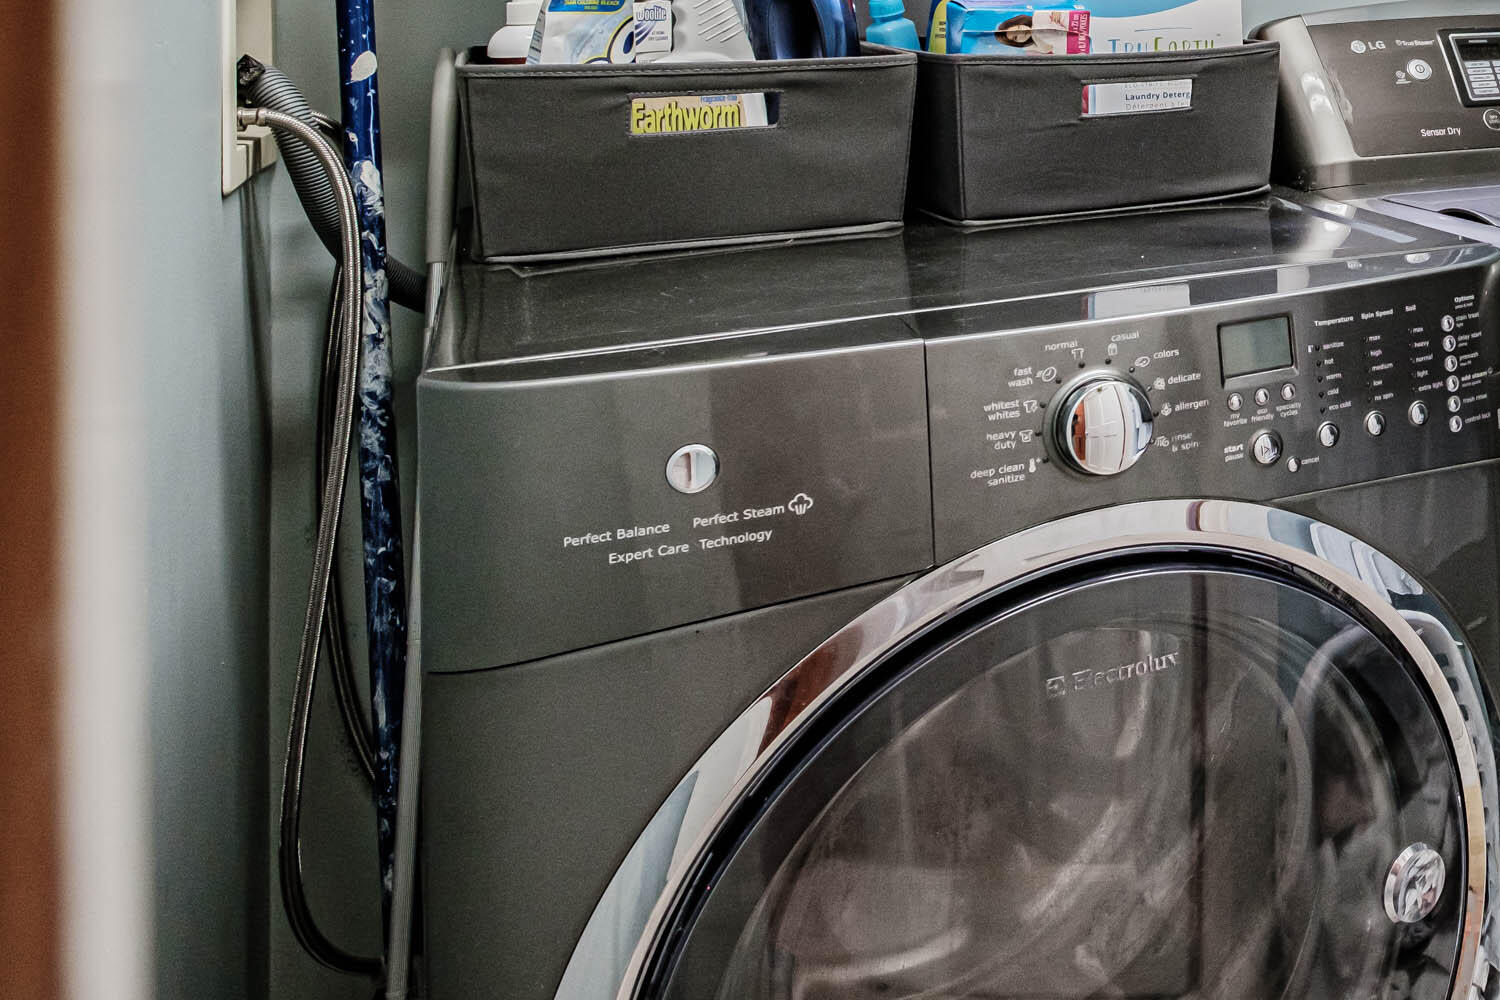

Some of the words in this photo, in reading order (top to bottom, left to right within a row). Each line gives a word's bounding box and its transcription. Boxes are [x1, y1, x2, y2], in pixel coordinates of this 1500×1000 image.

[636, 5, 667, 22] Woolite
[1368, 40, 1386, 50] LG
[1125, 92, 1160, 101] Laundry
[632, 101, 741, 134] Earthworm
[1420, 128, 1446, 137] Sensor
[1447, 126, 1460, 136] Dry
[1361, 312, 1374, 320] Spin
[1375, 308, 1394, 318] Speed
[1314, 316, 1354, 326] Temperature
[1111, 331, 1139, 342] casual
[1044, 340, 1078, 351] normal
[1153, 349, 1180, 359] colors
[1014, 366, 1032, 376] fast
[1008, 378, 1033, 388] wash
[1168, 372, 1201, 384] delicate
[1328, 388, 1339, 396] cold
[984, 400, 1020, 412] whitest
[1174, 400, 1209, 412] allergen
[988, 409, 1021, 422] whites
[1251, 413, 1274, 423] friendly
[1280, 409, 1298, 418] cycles
[986, 430, 1017, 441] heavy
[1172, 432, 1192, 441] rinse
[994, 440, 1016, 450] duty
[1181, 441, 1198, 450] spin
[1224, 444, 1244, 454] start
[1224, 453, 1244, 462] pause
[1301, 456, 1320, 464] cancel
[970, 466, 996, 480] deep
[998, 463, 1025, 474] clean
[987, 474, 1026, 486] sanitize
[692, 512, 739, 529] Perfect
[743, 504, 785, 520] Steam
[563, 532, 612, 548] Perfect
[616, 523, 670, 540] Balance
[700, 530, 772, 550] Technology
[608, 548, 654, 565] Expert
[658, 543, 690, 556] Care
